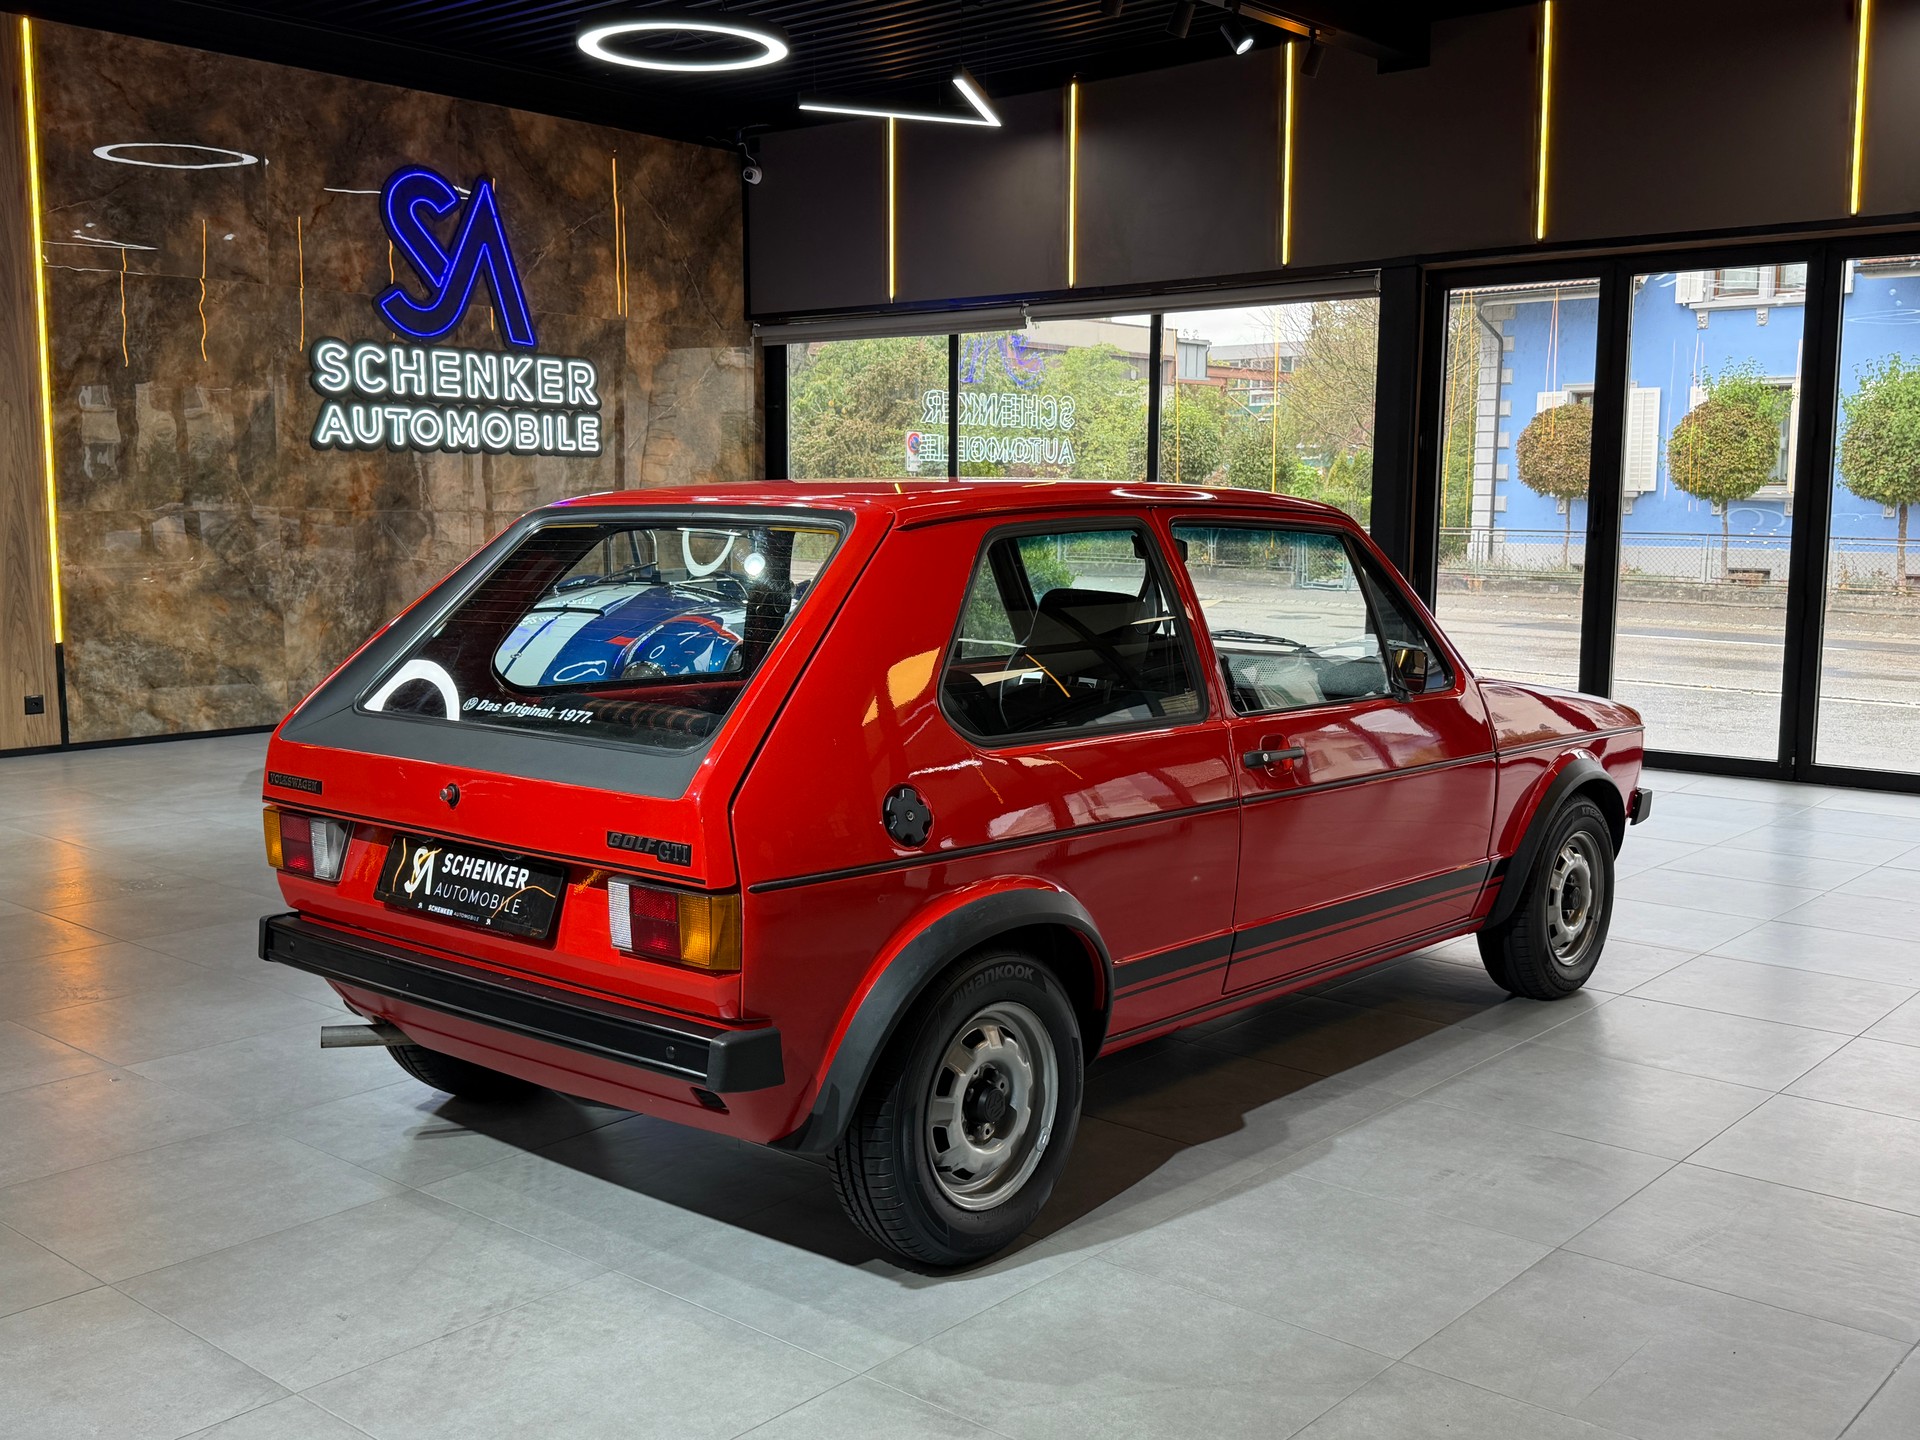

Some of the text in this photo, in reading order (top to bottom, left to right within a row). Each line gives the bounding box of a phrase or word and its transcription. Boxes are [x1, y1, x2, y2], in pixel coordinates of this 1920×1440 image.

[315, 341, 600, 407] SCHENKER
[315, 403, 601, 453] AUTOMOBILE
[476, 699, 502, 712] Das
[503, 701, 555, 719] Original.
[558, 708, 594, 724] 1977.
[269, 772, 318, 792] VOLKSWAGEN
[608, 832, 688, 864] GOLF GTI
[441, 852, 530, 890] SCHENKER
[428, 904, 454, 917] SCHENKER
[433, 881, 522, 915] AUTOMOBILE
